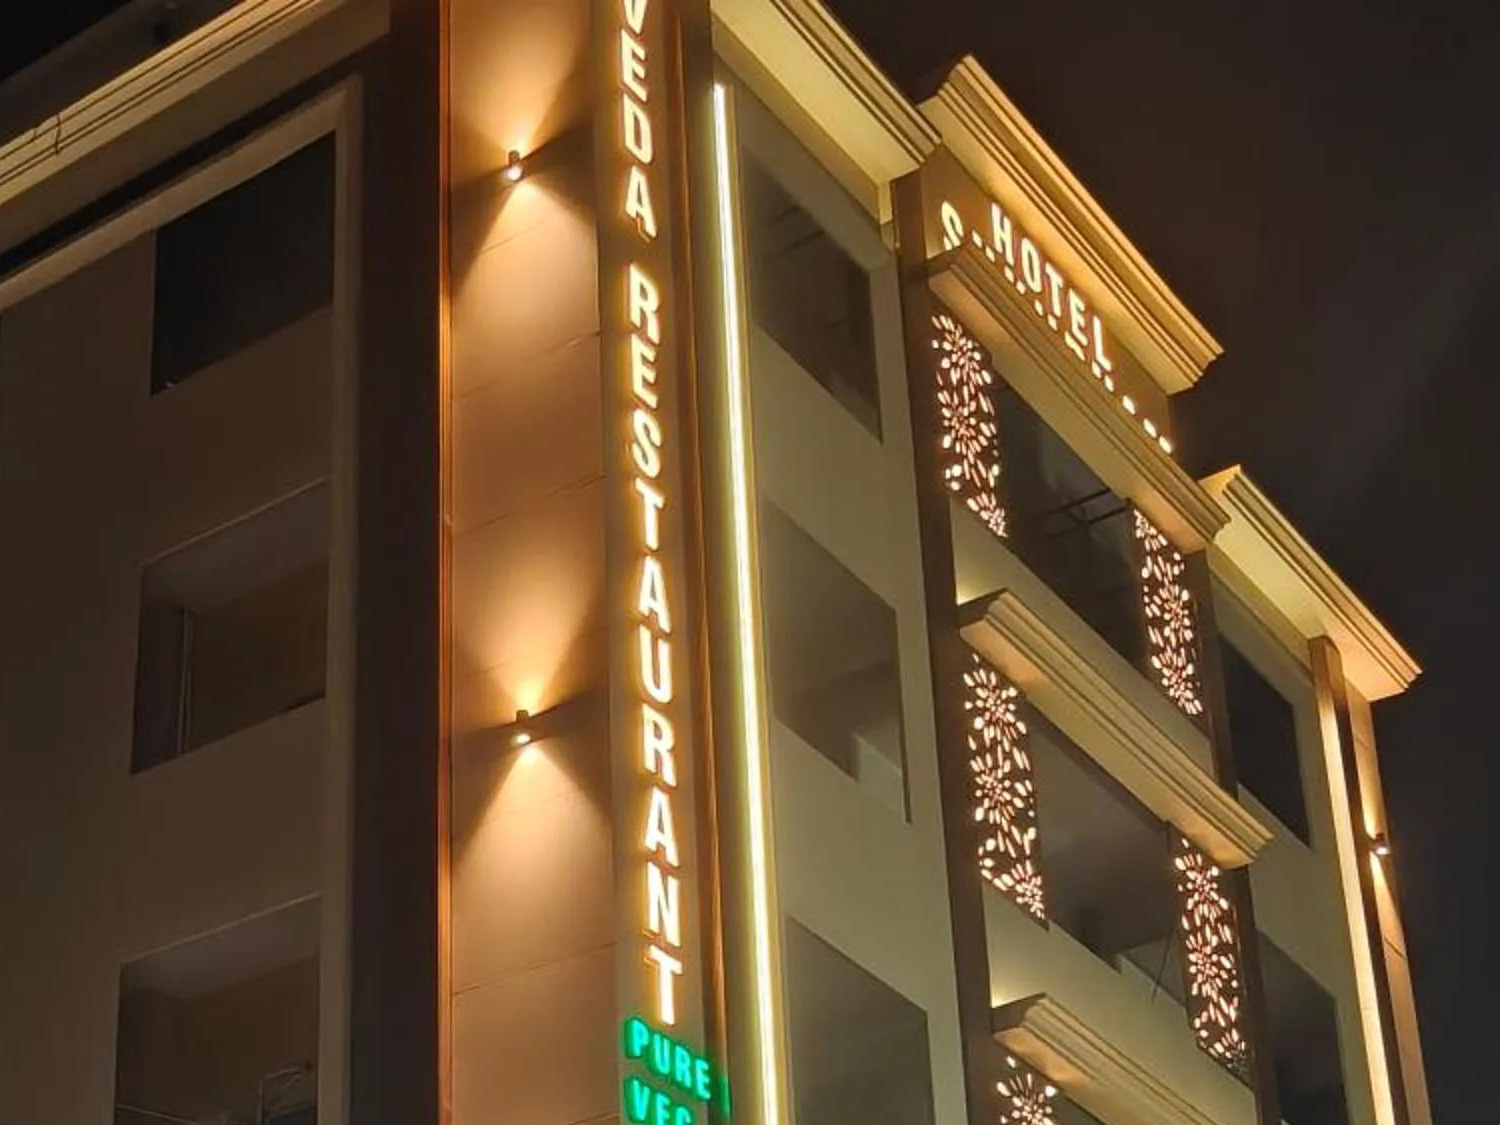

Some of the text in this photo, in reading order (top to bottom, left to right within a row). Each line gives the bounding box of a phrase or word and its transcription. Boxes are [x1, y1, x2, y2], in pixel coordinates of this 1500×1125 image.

[990, 202, 1113, 373] HOTEL
[629, 262, 684, 1025] RESTAURANT
[625, 1016, 712, 1101] PURE
